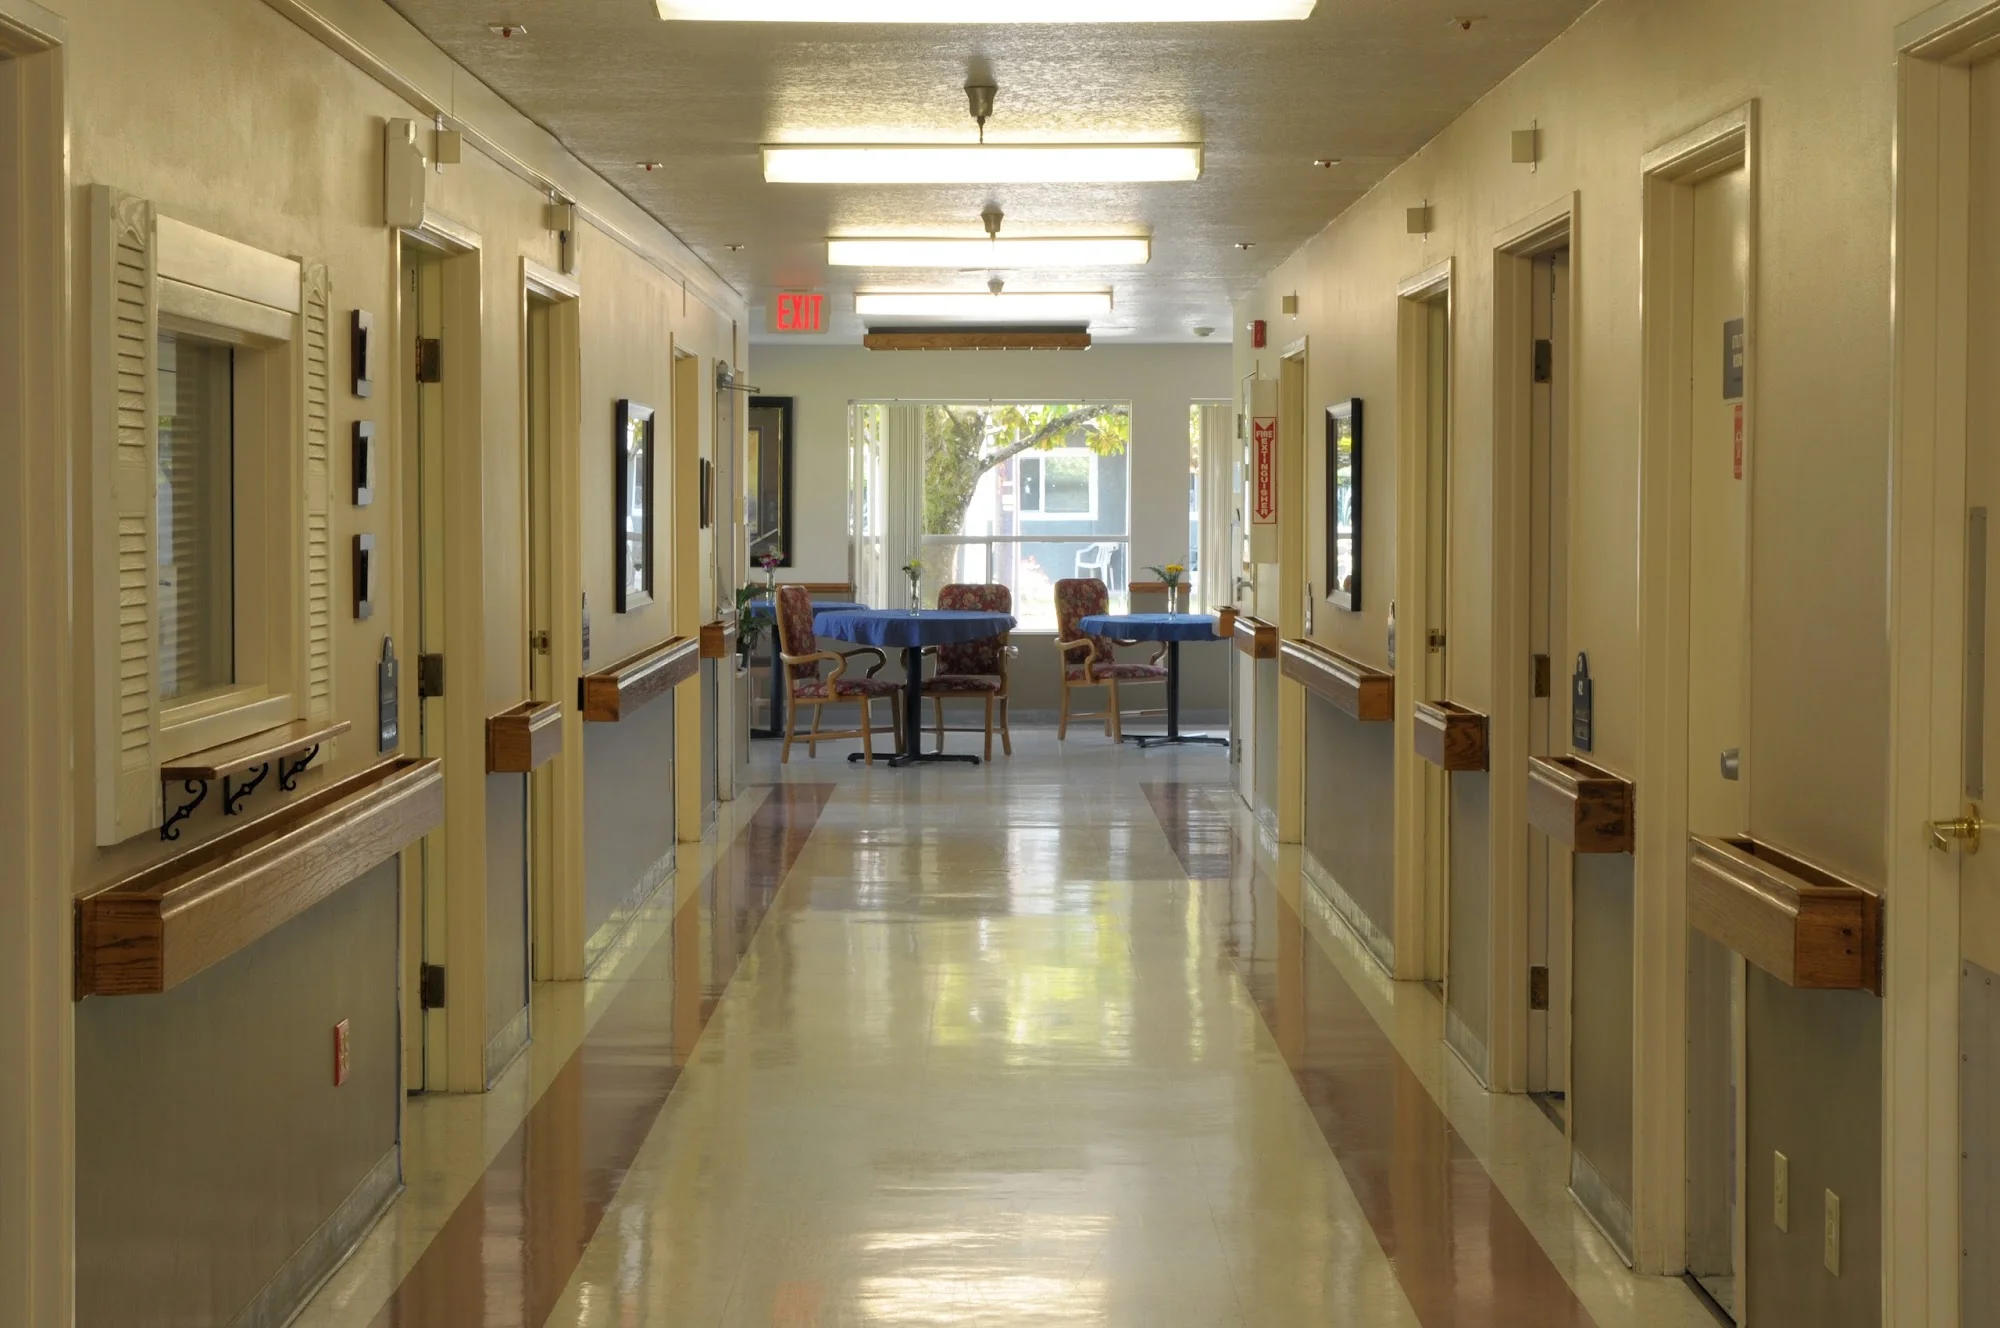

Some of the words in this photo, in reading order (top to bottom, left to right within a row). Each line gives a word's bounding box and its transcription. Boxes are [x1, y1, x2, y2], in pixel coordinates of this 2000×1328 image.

[777, 294, 823, 330] EXIT
[1256, 430, 1273, 438] FIRE
[1260, 438, 1268, 515] EXTINGUISHER
